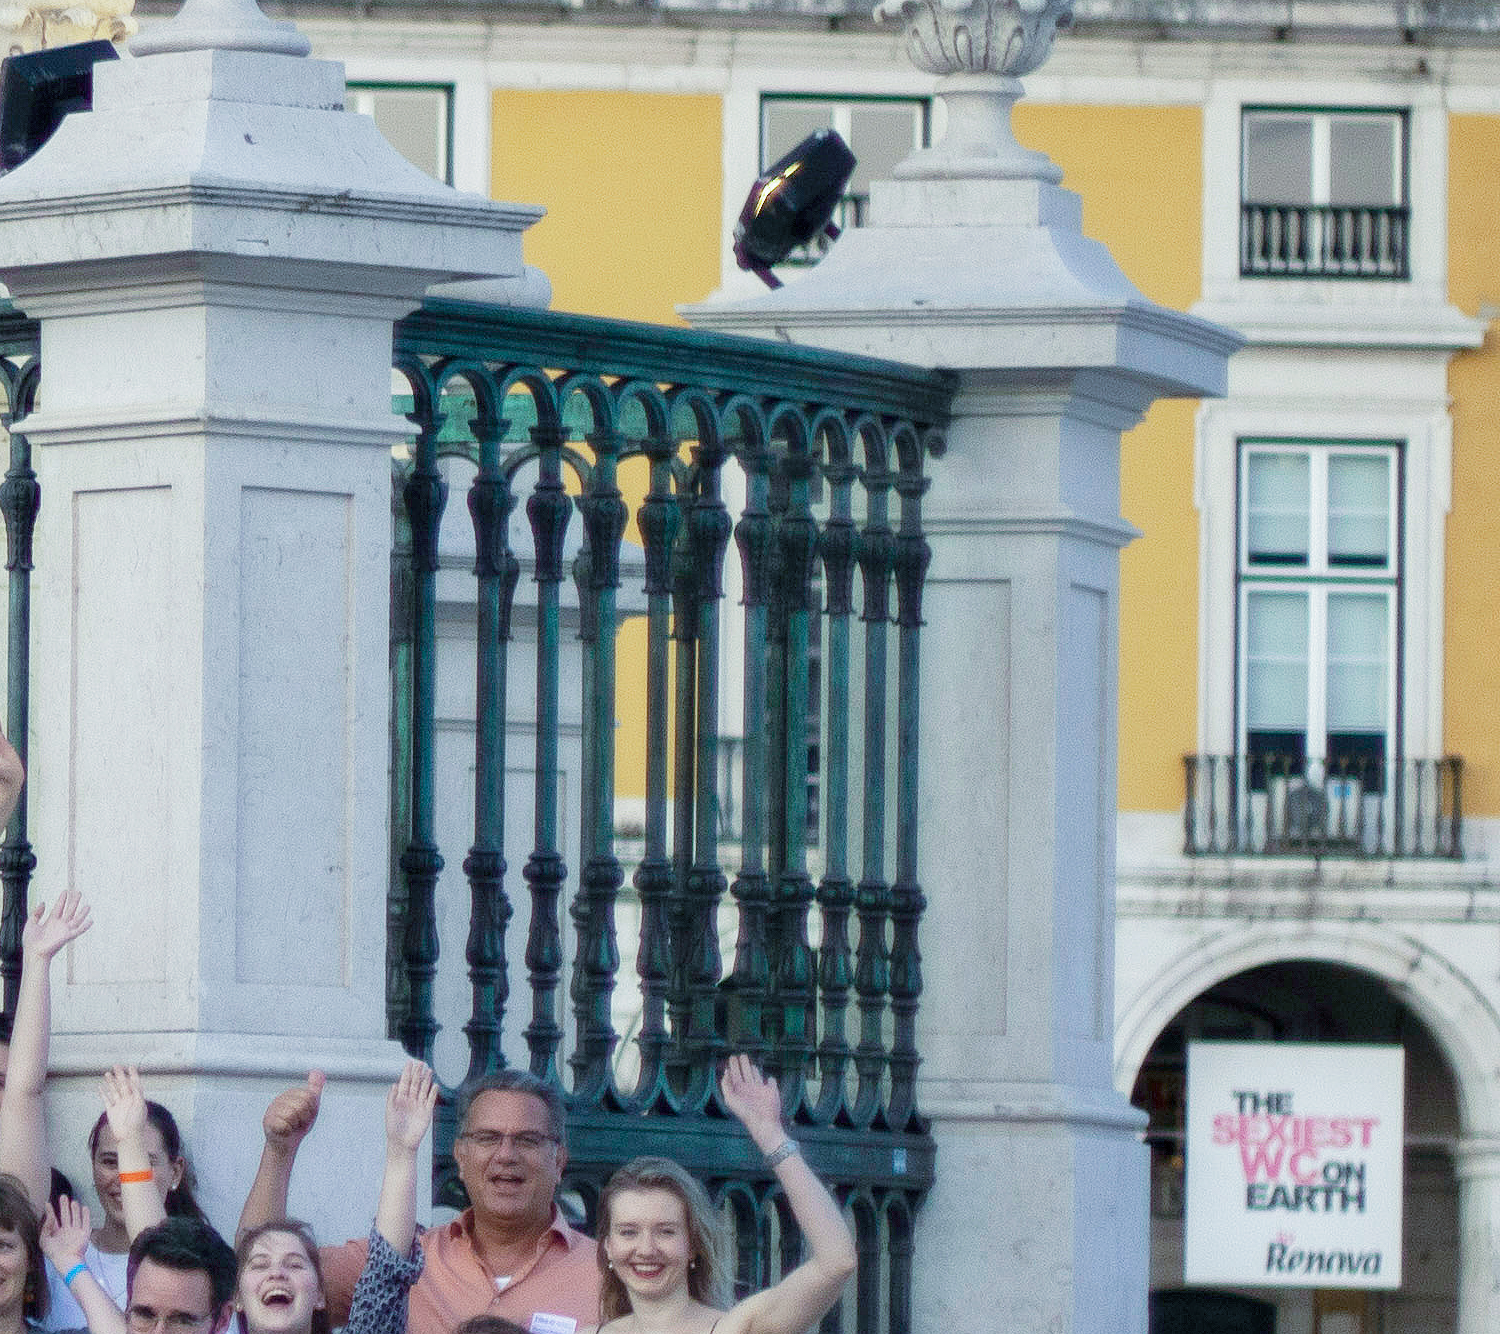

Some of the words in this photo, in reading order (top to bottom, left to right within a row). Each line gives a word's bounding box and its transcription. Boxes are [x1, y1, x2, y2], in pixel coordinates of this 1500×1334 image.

[1233, 1091, 1293, 1115] THE
[1213, 1115, 1379, 1146] SEXIEST
[1239, 1143, 1317, 1185] WC
[1323, 1161, 1366, 1184] ON
[1246, 1184, 1366, 1212] EARTH
[1266, 1242, 1381, 1274] Renova
